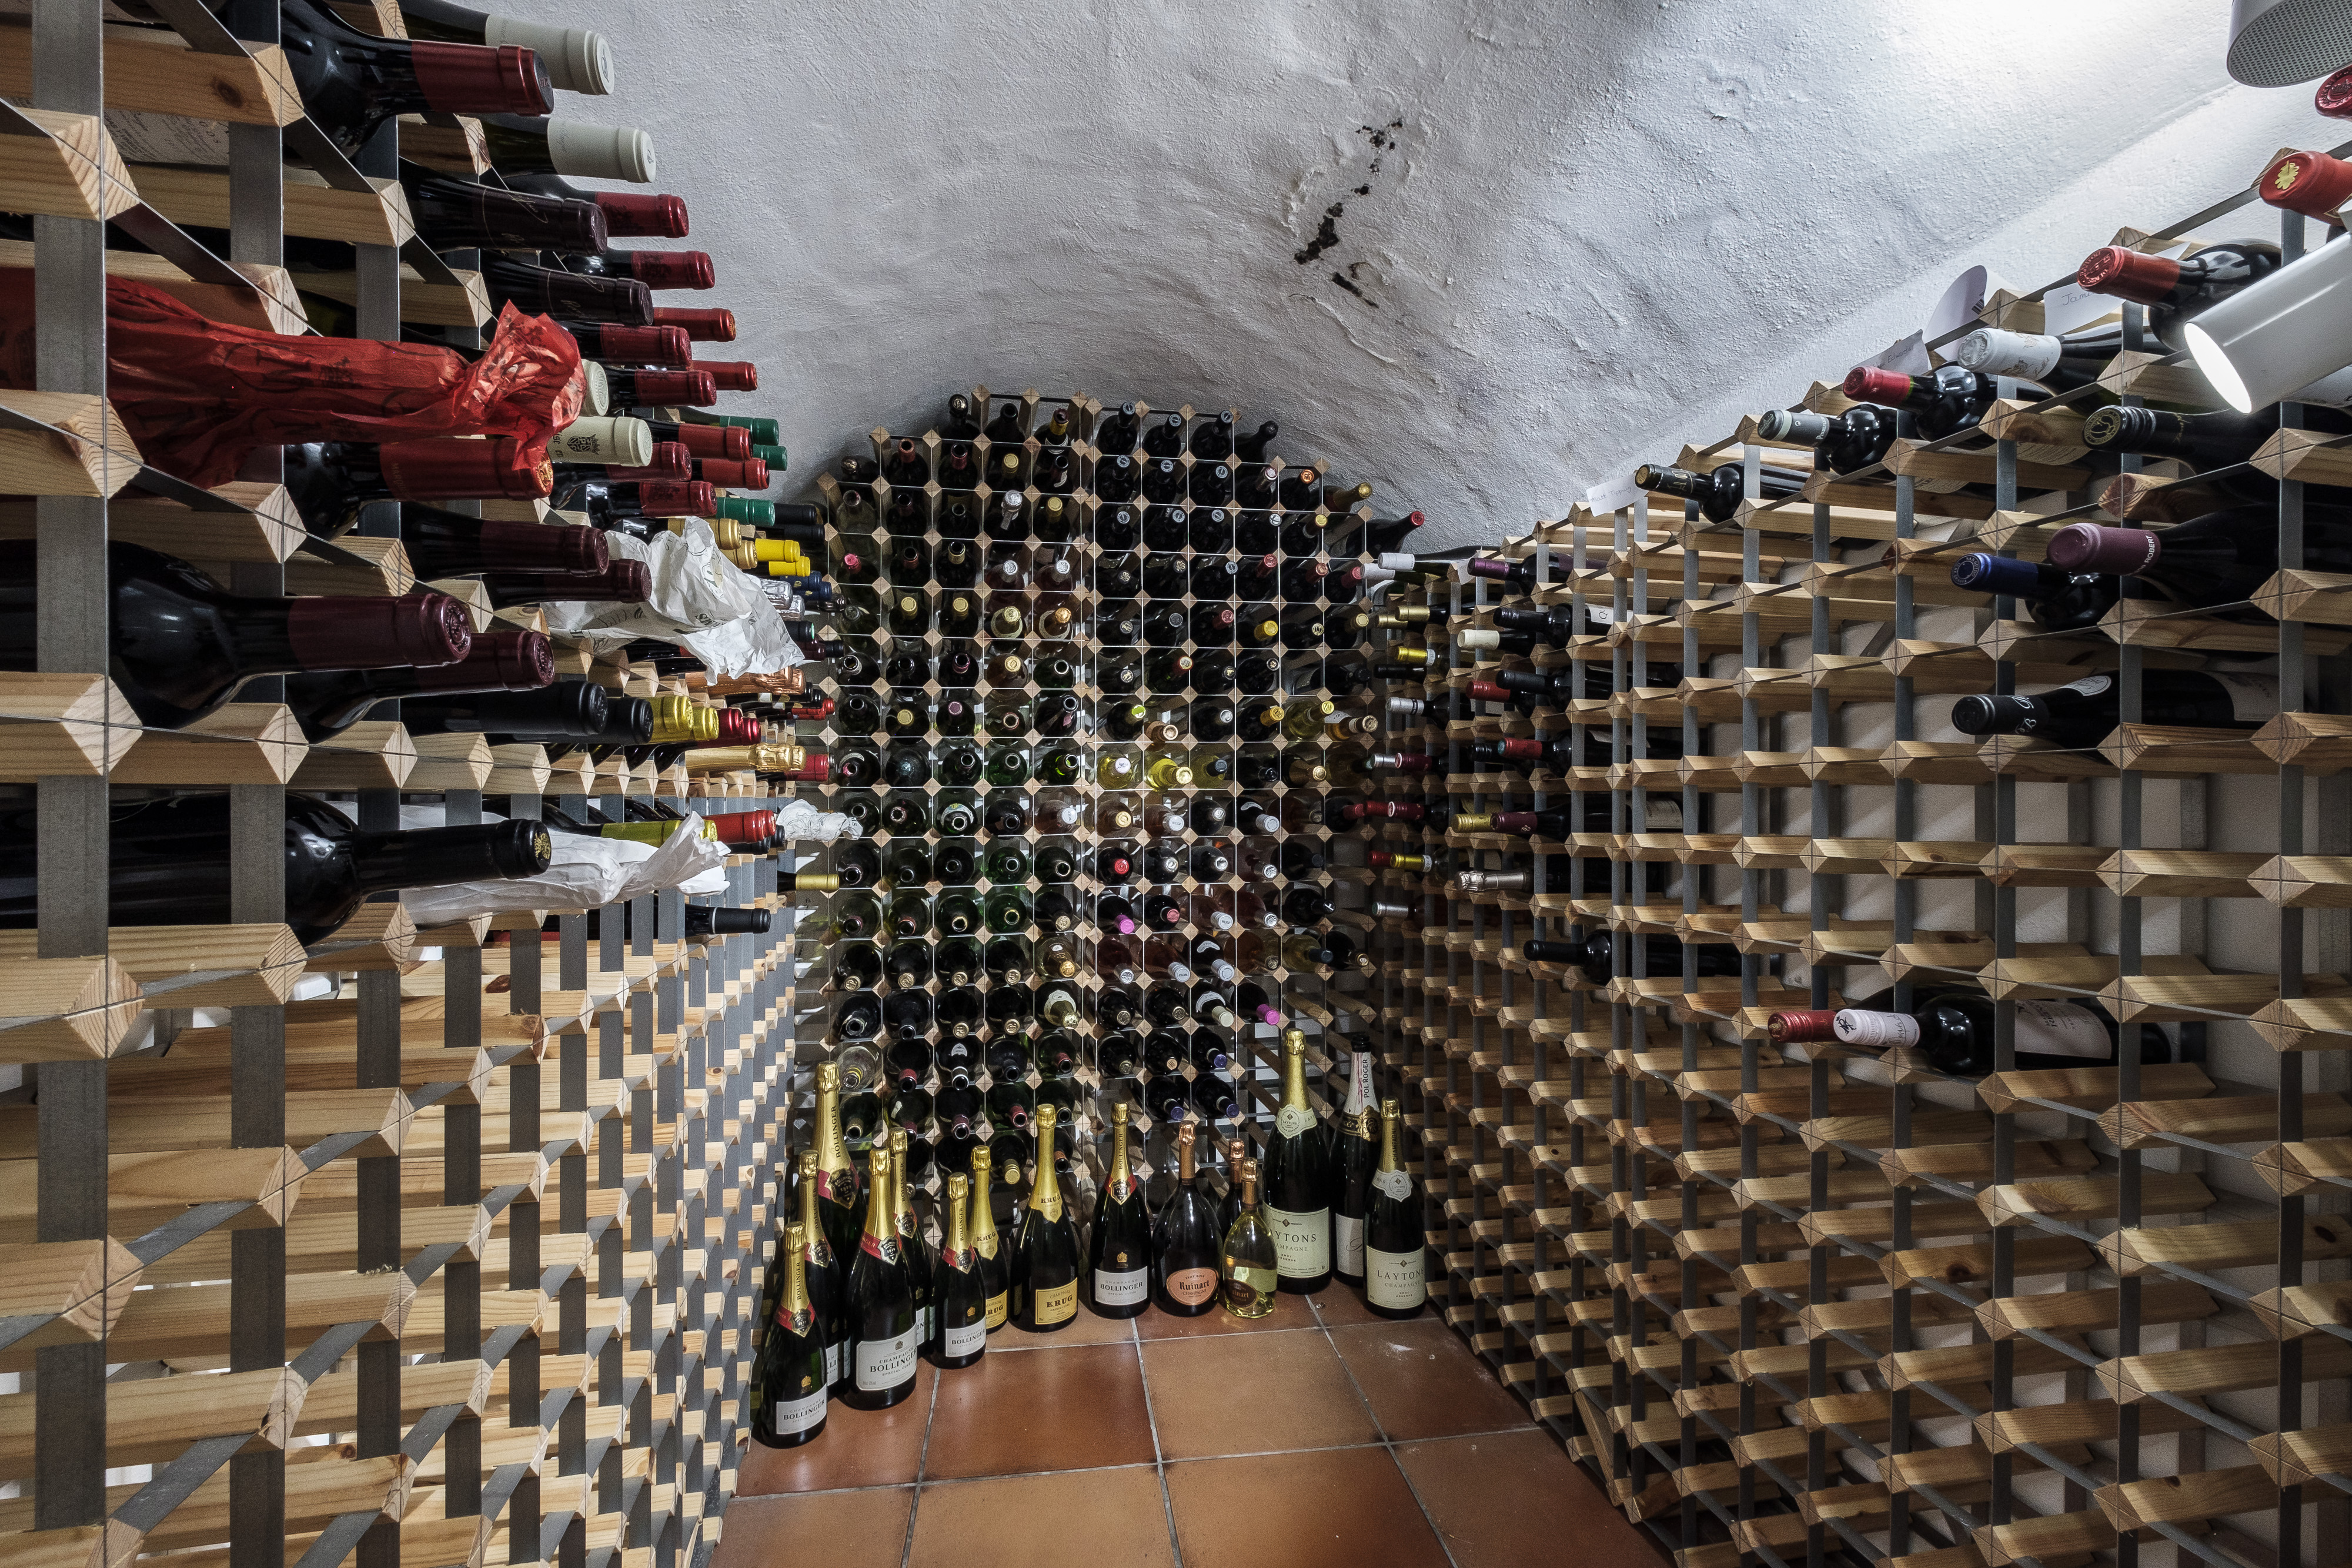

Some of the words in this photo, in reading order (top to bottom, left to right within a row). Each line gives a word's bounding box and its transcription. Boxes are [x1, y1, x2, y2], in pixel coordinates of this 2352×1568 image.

[2144, 534, 2156, 563] ROBERT
[831, 1105, 841, 1158] BOLLINGER
[1041, 1193, 1061, 1203] KRUG
[977, 1231, 996, 1242] KRUG
[1269, 1228, 1317, 1243] AYTONS
[1276, 1243, 1308, 1252] AMPAGNE
[1377, 1266, 1424, 1281] LAYTONS
[1100, 1282, 1143, 1292] BOLLINGER
[1179, 1280, 1210, 1290] Ruinart
[1385, 1281, 1421, 1289] CHAMPAGNE
[1046, 1294, 1073, 1308] KRUG
[987, 1304, 1004, 1316] RUG
[951, 1328, 985, 1345] BOLLINGER
[870, 1348, 917, 1373] BOLLINGER
[878, 1346, 914, 1365] CHAMPAGNE
[882, 1368, 901, 1376] SPECIAL
[783, 1399, 825, 1421] BOLLINGER
